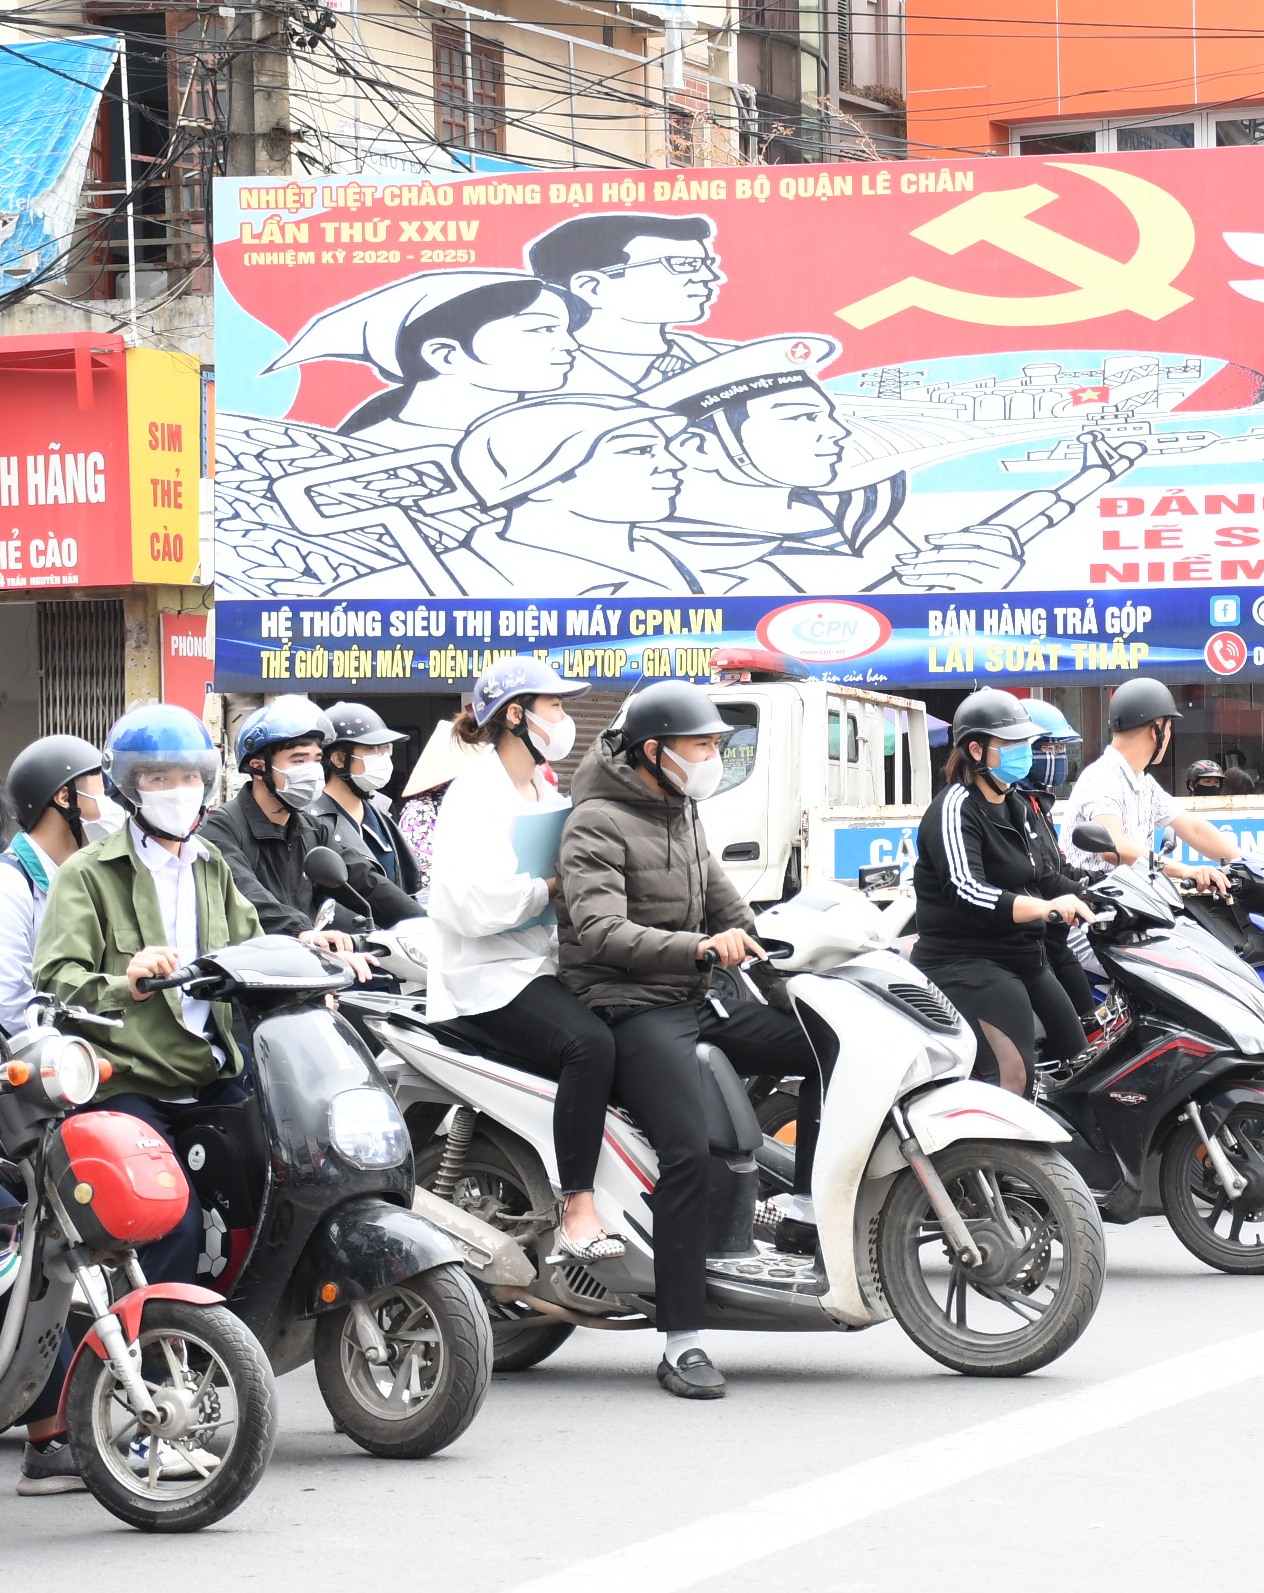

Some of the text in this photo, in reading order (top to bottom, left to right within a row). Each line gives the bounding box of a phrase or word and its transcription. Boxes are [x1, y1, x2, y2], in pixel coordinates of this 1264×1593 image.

[240, 168, 973, 213] NHIỆT LIỆT CHÀO MỪNG ĐẠI HỘI ĐẢNG BỘ QUẬN LÊ CHÂN
[241, 214, 480, 244] LẦN THỨ XXIV
[243, 249, 315, 267] (NHIỆM
[321, 249, 346, 264] KỲ
[352, 250, 400, 263] 2020
[420, 249, 475, 263] 2025)
[700, 375, 802, 407] HẢI QUÂN VIỆT NAM
[148, 421, 183, 453] SIM
[26, 442, 106, 506] HÃNG
[151, 467, 183, 510] THẺ
[29, 531, 78, 569] CÀO
[150, 525, 184, 563] CÀO
[1102, 524, 1184, 550] LẼ
[261, 602, 723, 643] HỆ THỐNG SIÊU THỊ ĐIỆN MÁY CPN.VN
[810, 620, 857, 638] CPN
[928, 598, 1152, 637] BÁN HÀNG TRẢ GÓP
[260, 642, 291, 679] THẾ
[294, 645, 328, 679] GIỚI
[332, 644, 372, 685] ĐIỆN
[376, 644, 414, 679] MÁY
[429, 644, 468, 685] ĐIỆN
[563, 648, 627, 678] LAPTOP
[642, 647, 671, 678] GIA
[928, 633, 1149, 673] LÃI SUẤT THẤP
